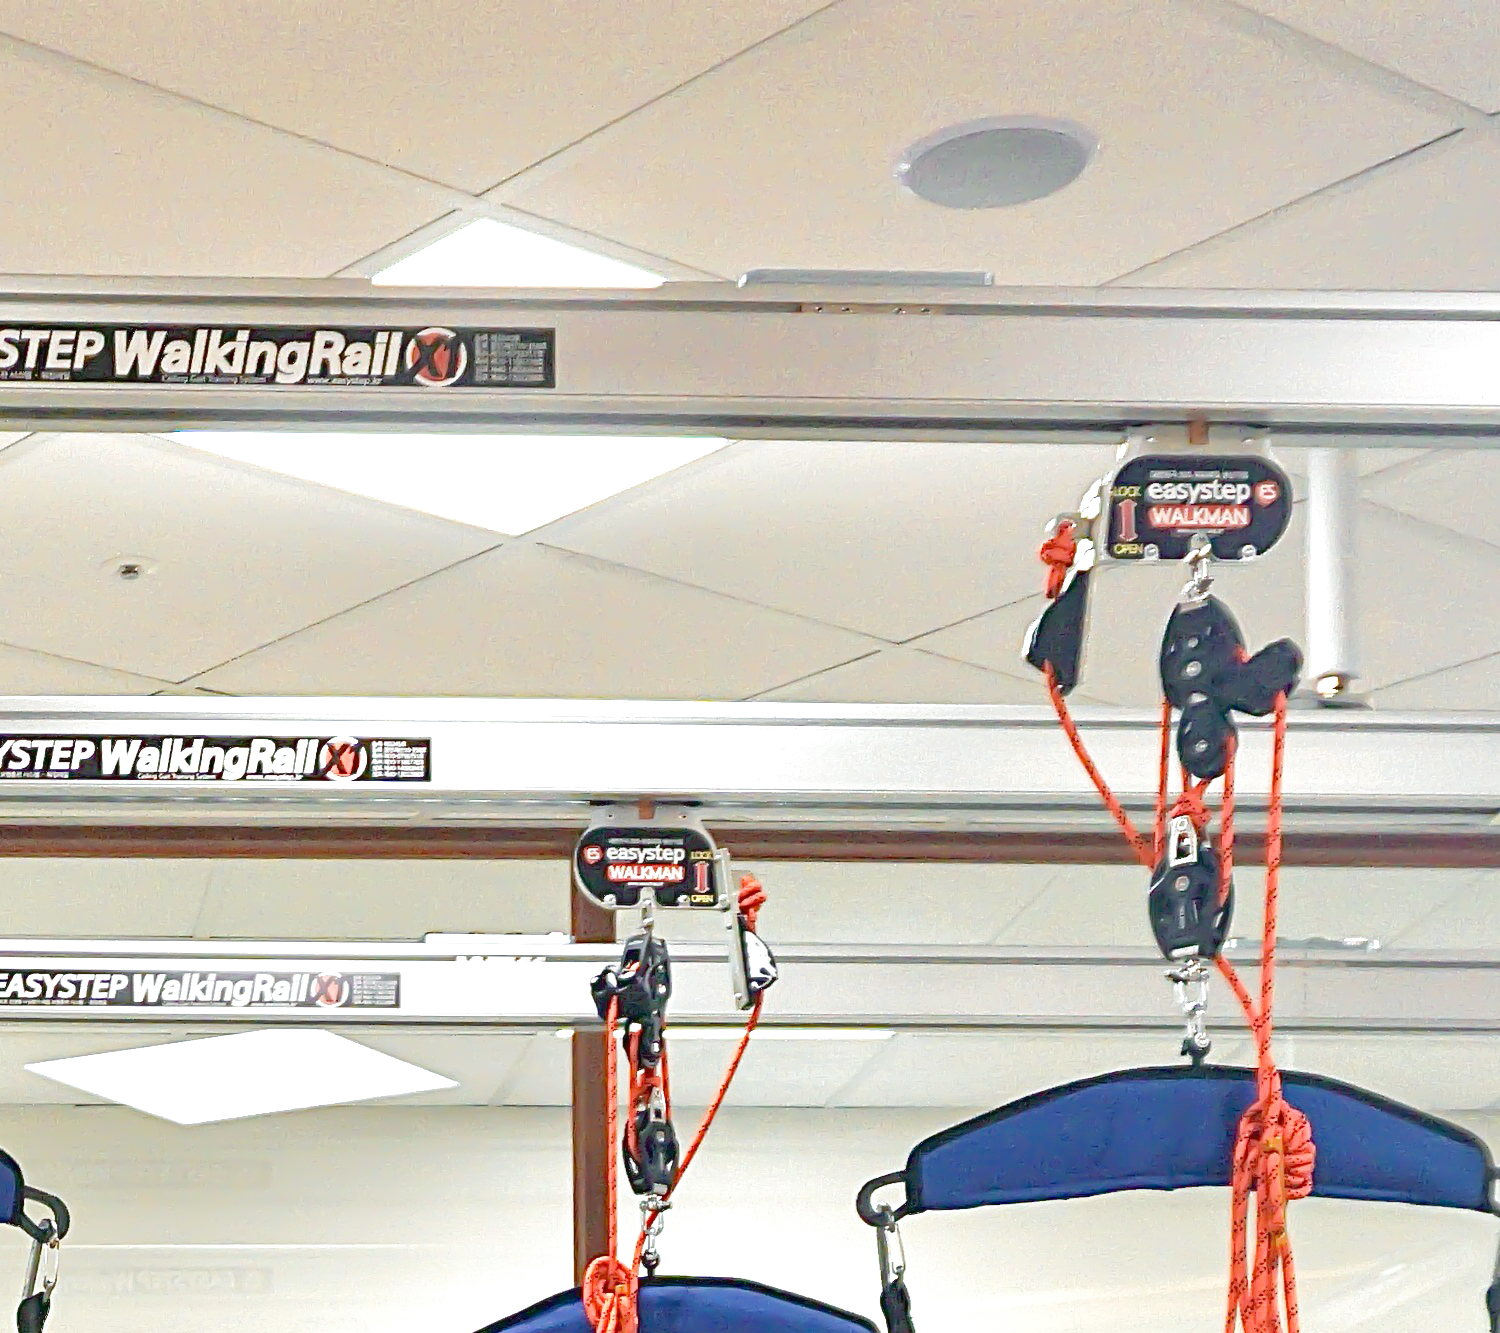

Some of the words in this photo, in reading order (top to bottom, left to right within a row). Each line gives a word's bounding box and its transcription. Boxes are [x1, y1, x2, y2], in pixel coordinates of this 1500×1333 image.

[113, 329, 403, 383] WalkingRail
[1149, 480, 1250, 504] easystep
[1152, 507, 1248, 525] WALKMAN
[1114, 543, 1144, 555] OPEN
[100, 738, 319, 780] WalkingRail
[606, 845, 686, 863] easystep
[608, 865, 683, 880] WALKMAN
[132, 973, 309, 1007] WalkingRail
